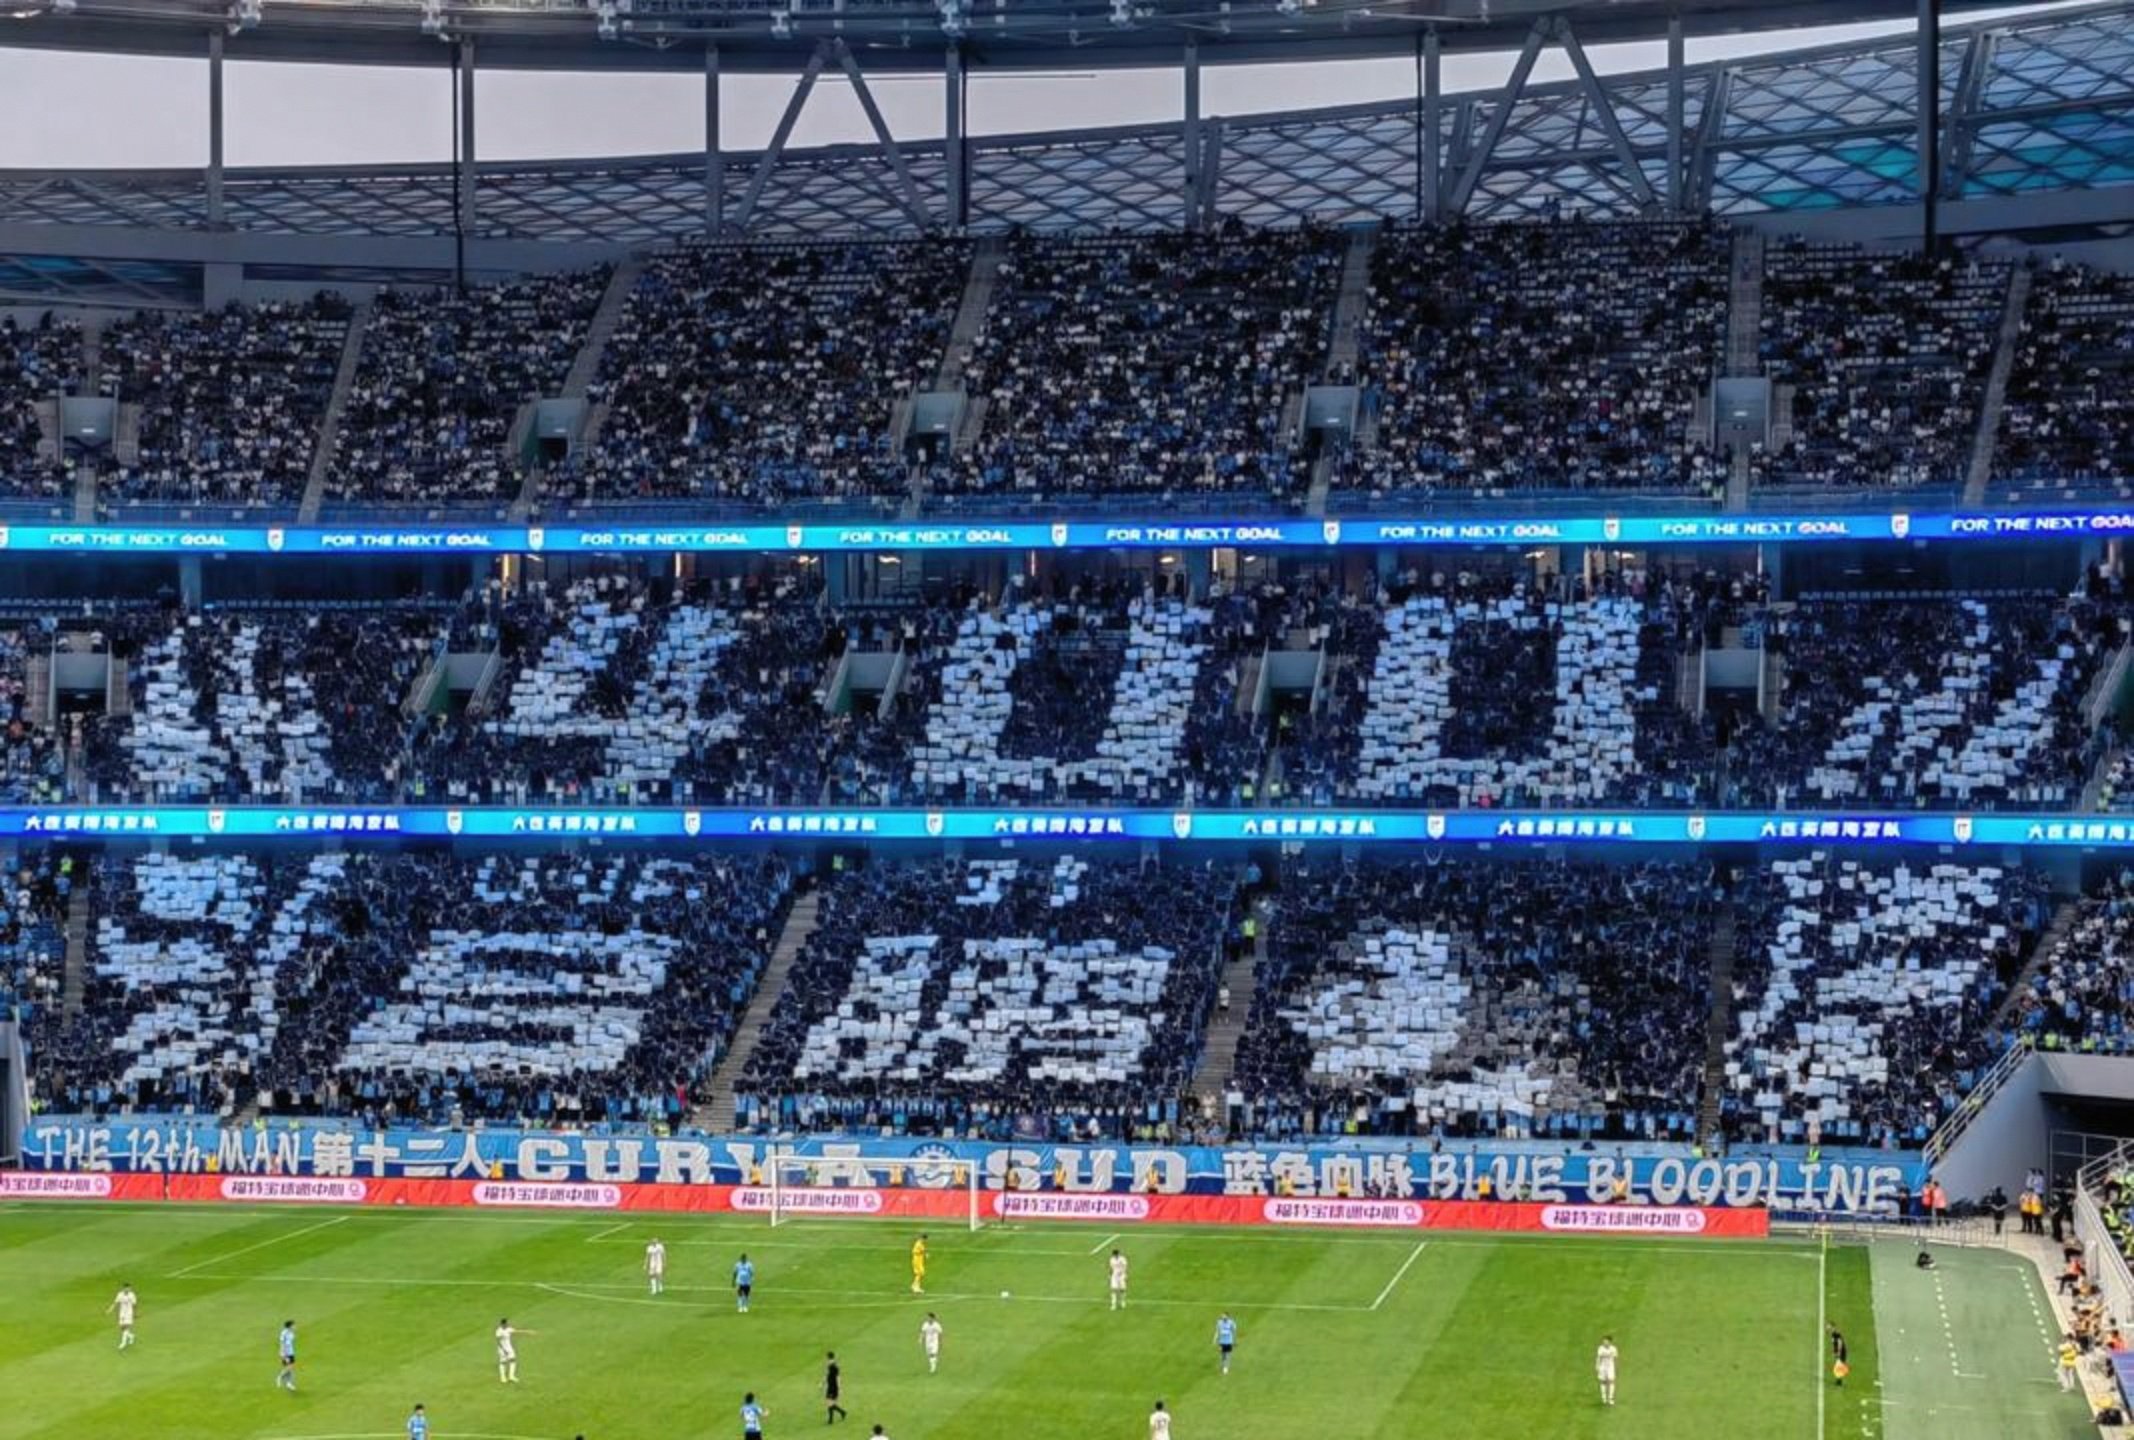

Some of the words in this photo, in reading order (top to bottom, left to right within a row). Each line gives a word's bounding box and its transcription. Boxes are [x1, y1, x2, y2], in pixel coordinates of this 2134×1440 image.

[1661, 522, 1698, 535] FOR
[1704, 522, 1738, 535] THE
[1743, 522, 1793, 535] NEXT
[1797, 522, 1850, 535] GOAL
[1951, 517, 1990, 531] FOR
[1994, 517, 2030, 531] THE
[2035, 517, 2087, 531] NEXT
[2090, 516, 2134, 529] GOA
[840, 530, 873, 543] FOR
[879, 530, 909, 543] THE
[915, 530, 961, 543] NEXT
[965, 530, 1012, 543] GOAL
[1106, 528, 1141, 541] FOR
[1146, 528, 1179, 541] THE
[1183, 528, 1231, 541] NEXT
[1235, 528, 1284, 541] GOAL
[1380, 525, 1416, 538] FOR
[1421, 525, 1455, 538] THE
[1459, 525, 1507, 538] NEXT
[1512, 525, 1561, 538] GOAL
[50, 533, 84, 545] FOR
[90, 533, 125, 545] THE
[129, 533, 174, 545] NEXT
[180, 533, 227, 545] GOAL
[322, 534, 356, 546] FOR
[361, 534, 393, 546] THE
[397, 534, 440, 546] NEXT
[446, 534, 492, 546] GOAL
[580, 533, 613, 545] FOR
[619, 533, 649, 545] THE
[654, 533, 699, 545] NEXT
[704, 533, 748, 545] GOAL
[36, 1126, 112, 1172] THE
[127, 1127, 200, 1173] 12th
[218, 1129, 299, 1175] MAN
[312, 1130, 491, 1178] 第十二人
[517, 1138, 877, 1187] CURVA
[985, 1148, 1187, 1194] SUD
[1223, 1151, 1414, 1199] 蓝色血脉
[1428, 1153, 1567, 1203] BLUE
[1587, 1157, 1901, 1217] BLOODLINE
